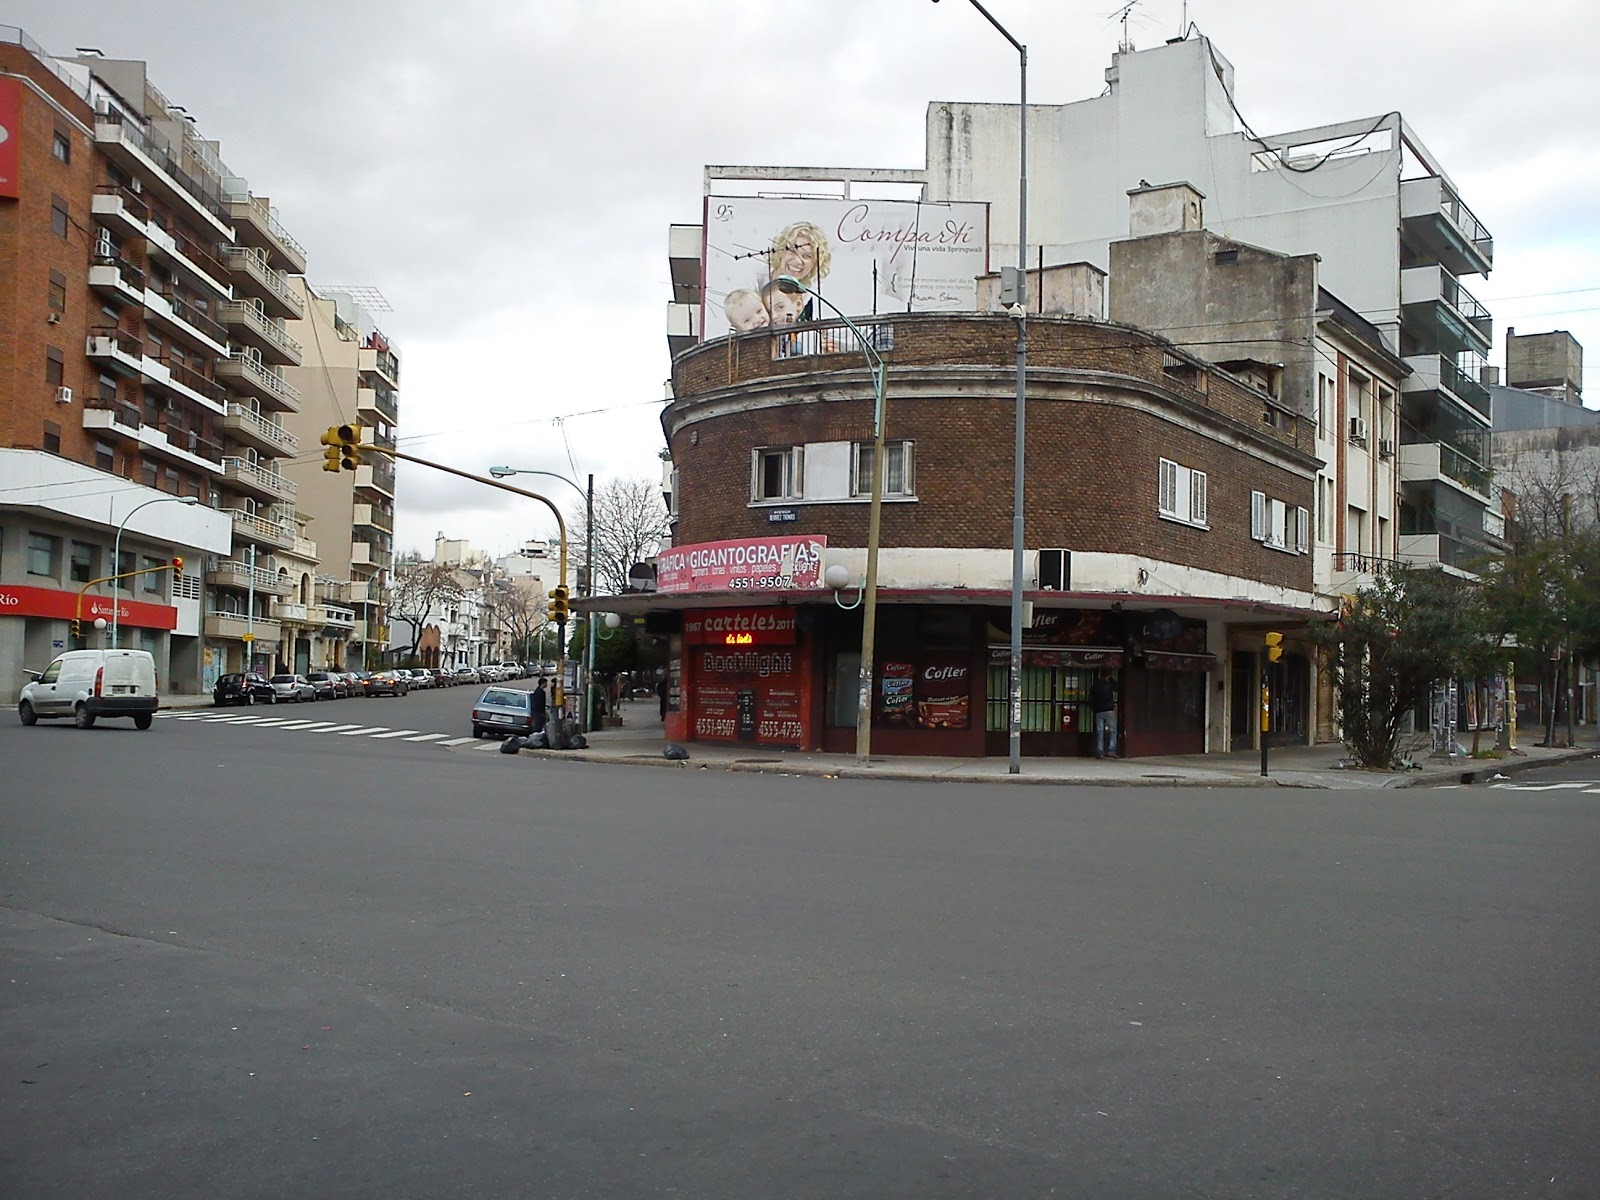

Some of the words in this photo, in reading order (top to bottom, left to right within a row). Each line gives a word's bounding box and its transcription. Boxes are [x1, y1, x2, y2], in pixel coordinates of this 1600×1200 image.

[837, 204, 974, 264] Compartí
[947, 246, 983, 254] Springwall
[690, 543, 820, 568] GIGANTOGRAFIAS
[752, 562, 776, 577] papeles
[728, 575, 791, 589] 4551-9507
[704, 613, 776, 632] carteles
[776, 618, 795, 630] 2011
[703, 652, 792, 677] Backlight
[886, 663, 906, 672] Cofler
[925, 666, 966, 680] Cofler
[886, 696, 909, 705] Cofler
